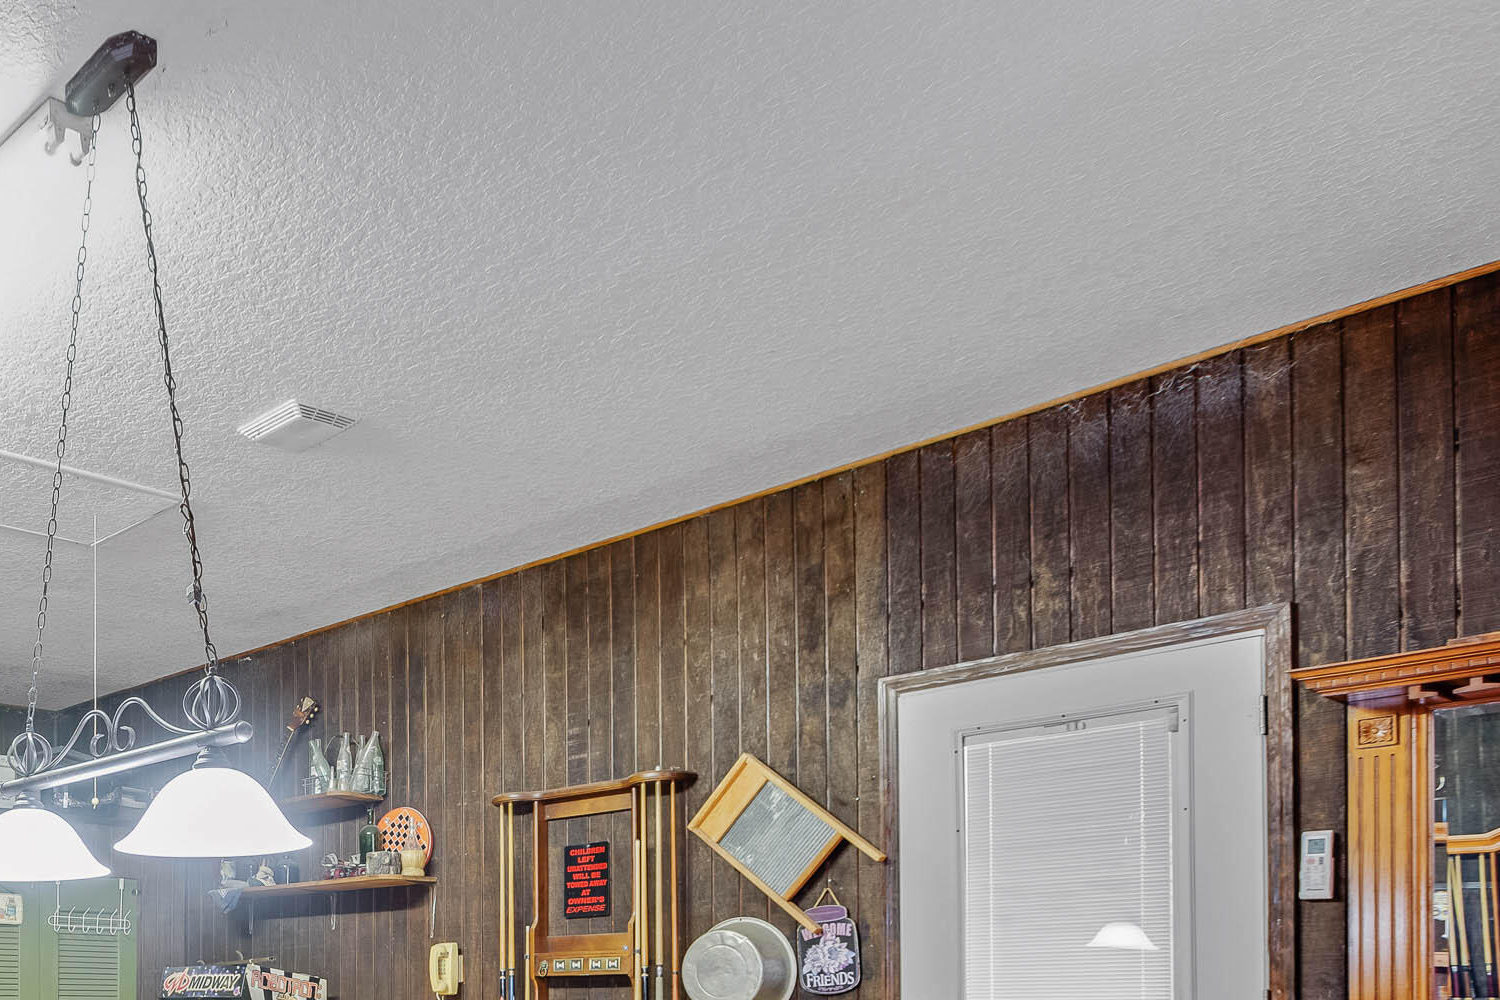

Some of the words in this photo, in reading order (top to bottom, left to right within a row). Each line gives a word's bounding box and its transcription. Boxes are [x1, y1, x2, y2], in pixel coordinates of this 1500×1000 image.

[569, 846, 605, 857] CHILDREN
[577, 855, 596, 864] LEFT
[572, 872, 590, 880] WILL
[590, 871, 602, 879] BE
[566, 880, 589, 889] TOWED
[589, 879, 608, 887] AWAY
[580, 888, 591, 897] AT
[565, 904, 607, 914] EXPENSE
[801, 922, 853, 942] WCOME
[188, 973, 241, 992] MIDWAY
[806, 971, 855, 988] FRIENDS
